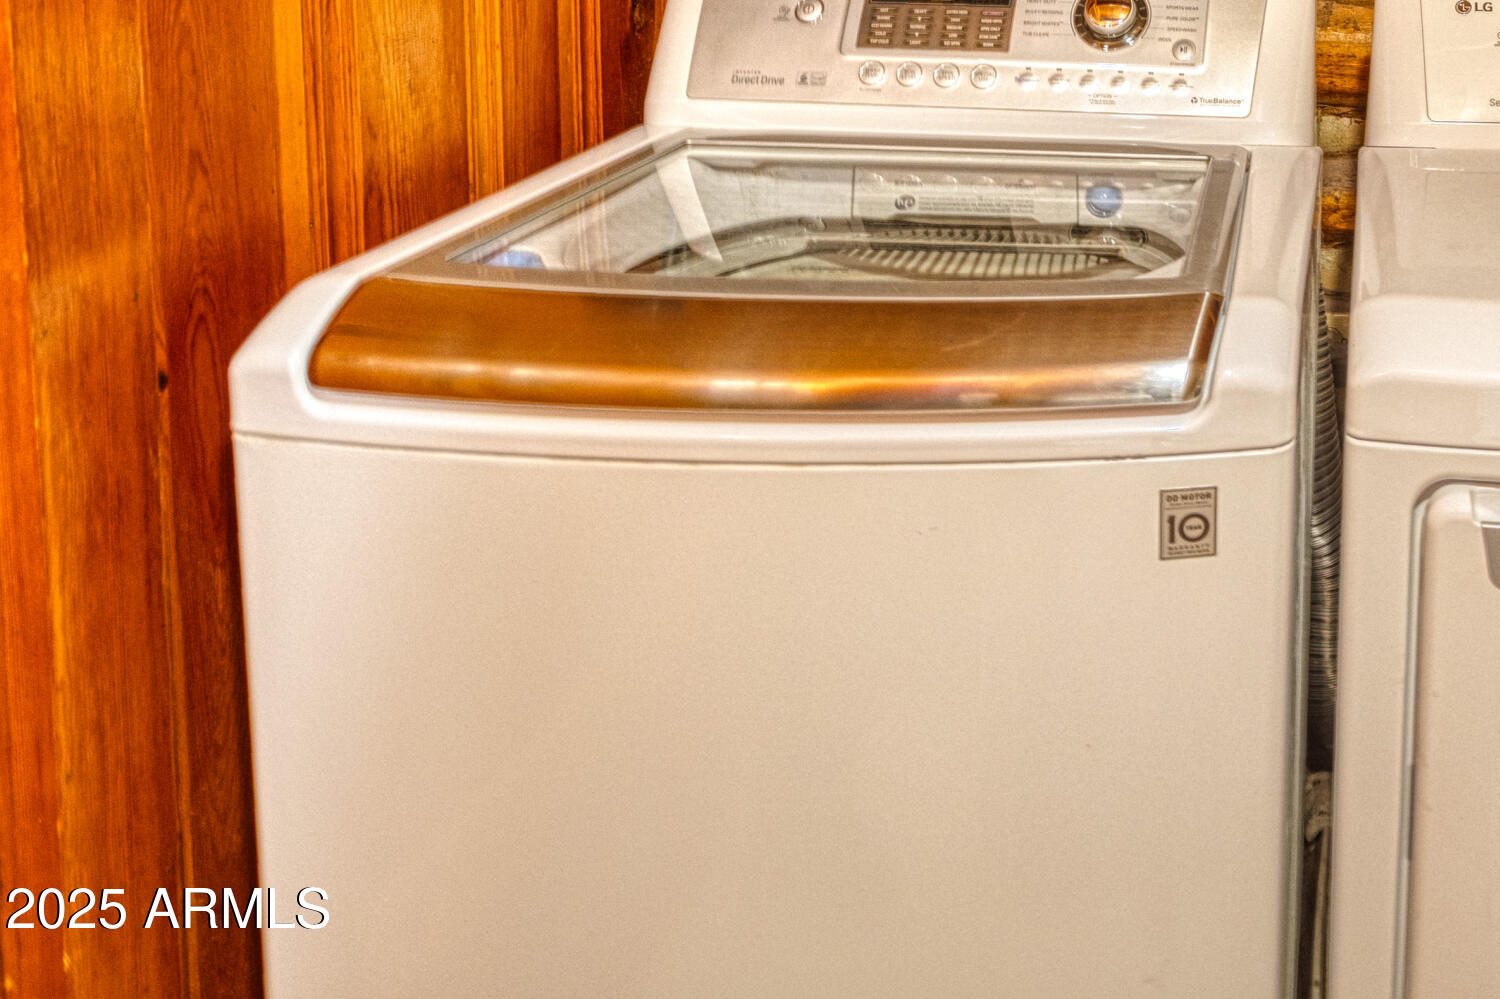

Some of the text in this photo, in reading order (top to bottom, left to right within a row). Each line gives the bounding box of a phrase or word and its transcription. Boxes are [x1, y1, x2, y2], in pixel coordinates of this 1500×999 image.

[1474, 2, 1493, 13] LG
[731, 74, 759, 86] Direct
[761, 75, 785, 87] Drive
[1180, 492, 1212, 501] MOTOR
[1167, 513, 1210, 545] 10
